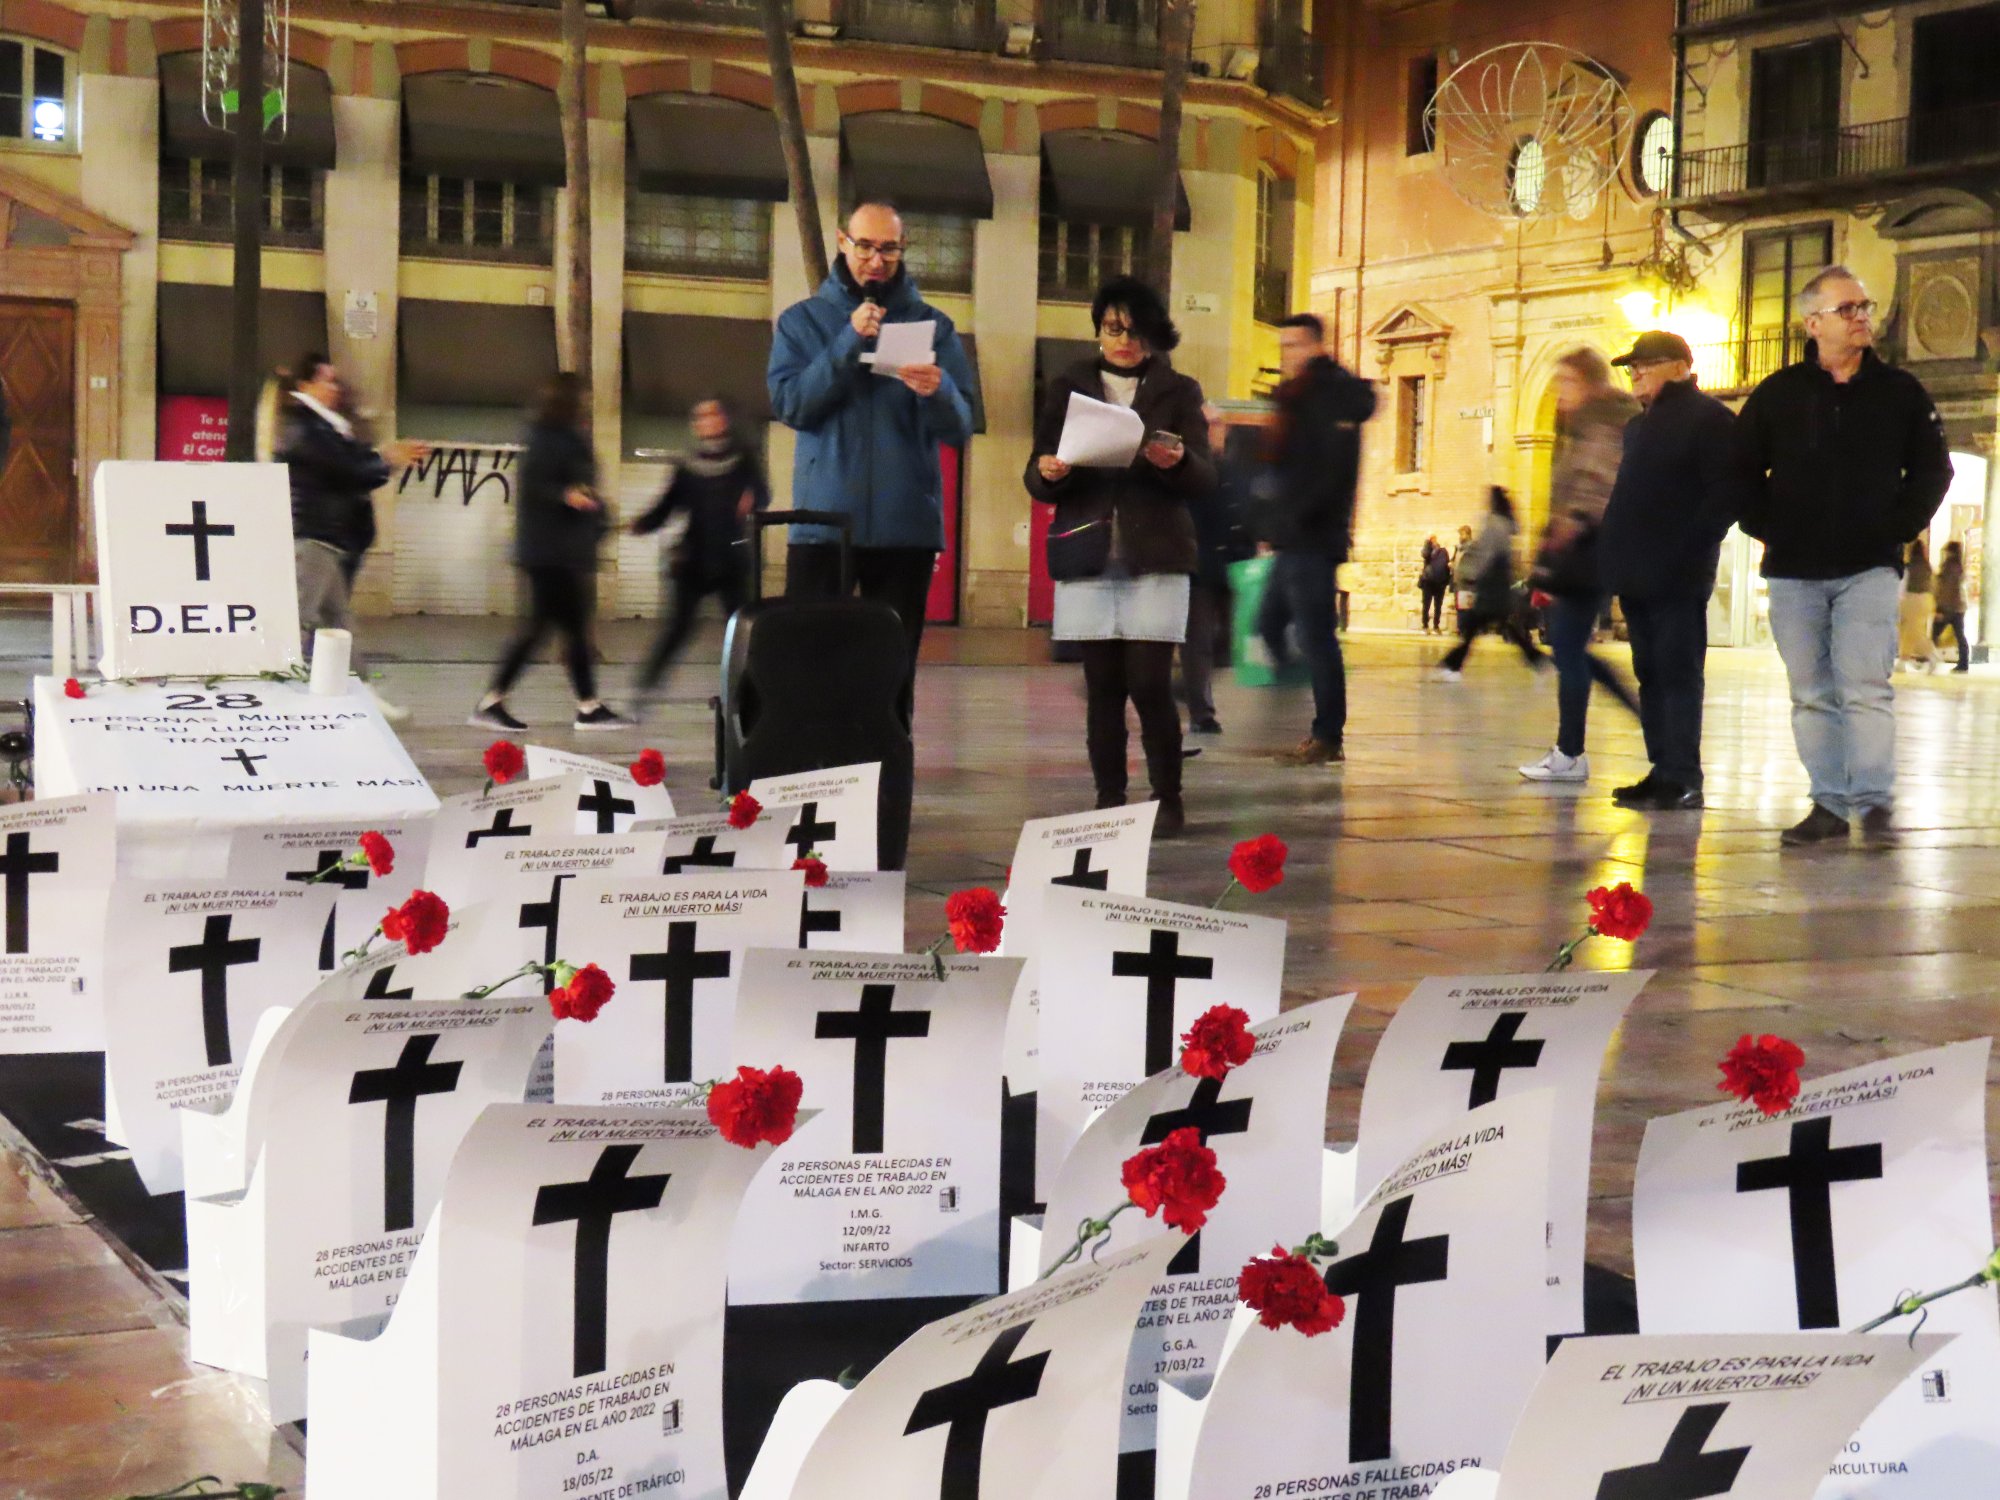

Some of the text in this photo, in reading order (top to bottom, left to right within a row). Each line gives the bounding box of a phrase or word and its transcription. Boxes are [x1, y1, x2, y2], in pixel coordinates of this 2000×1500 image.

[200, 414, 213, 424] Te
[183, 444, 195, 455] El
[165, 693, 263, 711] 28
[70, 714, 217, 724] PERSONAS
[105, 723, 345, 733] EN SU LUGAR DE
[224, 782, 339, 792] MUERTE
[600, 889, 768, 904] EL TRABAJO ES PARA LA VIDA
[643, 906, 659, 915] UN
[662, 904, 711, 914] MUERTO
[715, 902, 742, 913] MÁS!
[1082, 900, 1094, 908] EL
[1100, 902, 1151, 914] TRABAJO
[1154, 909, 1170, 917] ES
[1173, 912, 1202, 922] PARA
[1222, 920, 1249, 929] VIDA
[1125, 914, 1141, 922] UN
[1145, 916, 1192, 928] MUERTO
[858, 971, 914, 979] MUERTO
[893, 963, 927, 971] PARA
[950, 964, 979, 972] VIDA
[345, 1006, 534, 1022] EL TRABAJO ES PARA LA VIDA
[388, 1022, 407, 1030] UN
[408, 1018, 465, 1029] MUERTO
[1269, 1020, 1311, 1038] LA VIDA
[1083, 1082, 1094, 1090] 28
[602, 1089, 672, 1100] 28 PERSONAS
[1700, 1067, 1934, 1127] EL ES PARA LA VIDA
[1758, 1112, 1778, 1123] UN
[1785, 1096, 1852, 1118] MUERTO
[526, 1119, 696, 1128] EL TRABAJO ES PARA
[578, 1130, 602, 1138] UN
[606, 1129, 674, 1137] MUERTO
[1422, 1125, 1504, 1160] PARA LA VIDA
[781, 1158, 951, 1171] 28 PERSONAS FALLECIDAS EN
[780, 1171, 946, 1184] ACCIDENTES DE TRABAJO EN
[1388, 1163, 1435, 1193] MUERTO
[794, 1184, 932, 1198] MÁLAGA EN EL AÑO 2022
[843, 1226, 891, 1236] 12/09/22
[316, 1239, 392, 1262] 28 PERSONAS
[843, 1242, 889, 1252] INFARTO
[315, 1252, 404, 1278] ACCIDENTES DE
[820, 1258, 912, 1270] Sector: SERVICIOS
[329, 1268, 408, 1290] MÁLAGA EN EL
[1171, 1297, 1186, 1309] DE
[1158, 1309, 1219, 1326] EN EL AÑO
[1163, 1339, 1197, 1352] G.G.A.
[1154, 1357, 1205, 1373] 17/03/22
[1600, 1354, 1874, 1381] EL TRABAJO ES PARA LA VIDA
[496, 1363, 674, 1418] 28 PERSONAS FALLECIDAS EN
[1129, 1380, 1158, 1395] CAÍD
[1658, 1380, 1688, 1395] UN
[1692, 1375, 1773, 1392] MUERTO
[494, 1382, 670, 1436] ACCIDENTES DE TRABAJO EN
[510, 1403, 656, 1451] MÁLAGA EN EL AÑO 2022
[577, 1449, 599, 1464] D.A.
[563, 1467, 614, 1492] 18/05/22
[619, 1486, 632, 1499] DE
[636, 1469, 685, 1493] TRÁFICO)
[1254, 1485, 1271, 1499] 28
[1276, 1472, 1360, 1496] PERSONAS
[1365, 1460, 1454, 1484] FALLECIDAS
